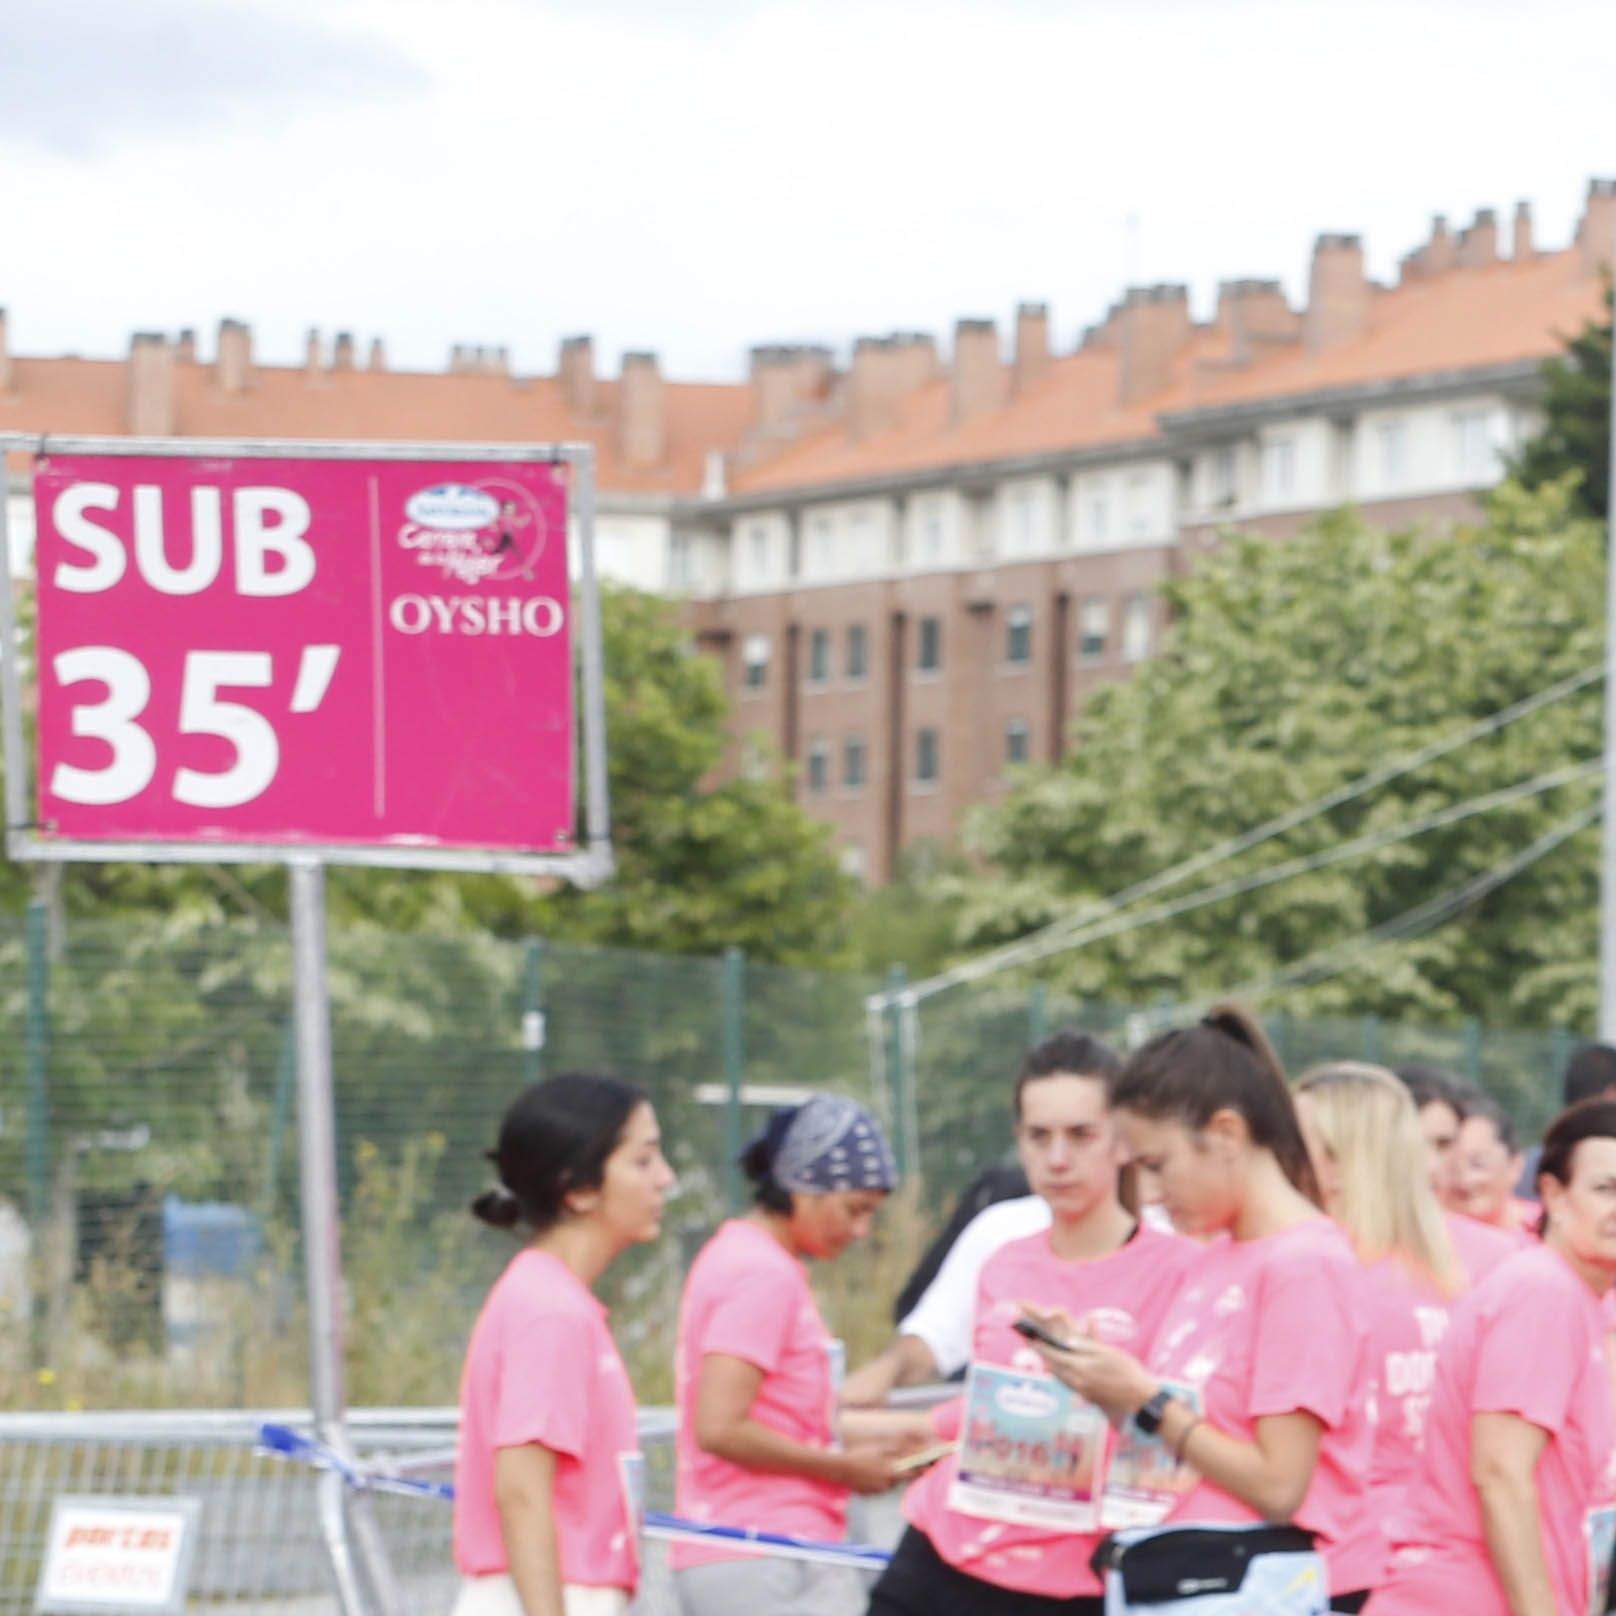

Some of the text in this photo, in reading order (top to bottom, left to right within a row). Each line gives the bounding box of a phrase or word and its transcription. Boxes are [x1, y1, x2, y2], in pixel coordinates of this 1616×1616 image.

[52, 481, 317, 597] SUB
[389, 592, 565, 638] OYSHO
[49, 643, 341, 808] 35'
